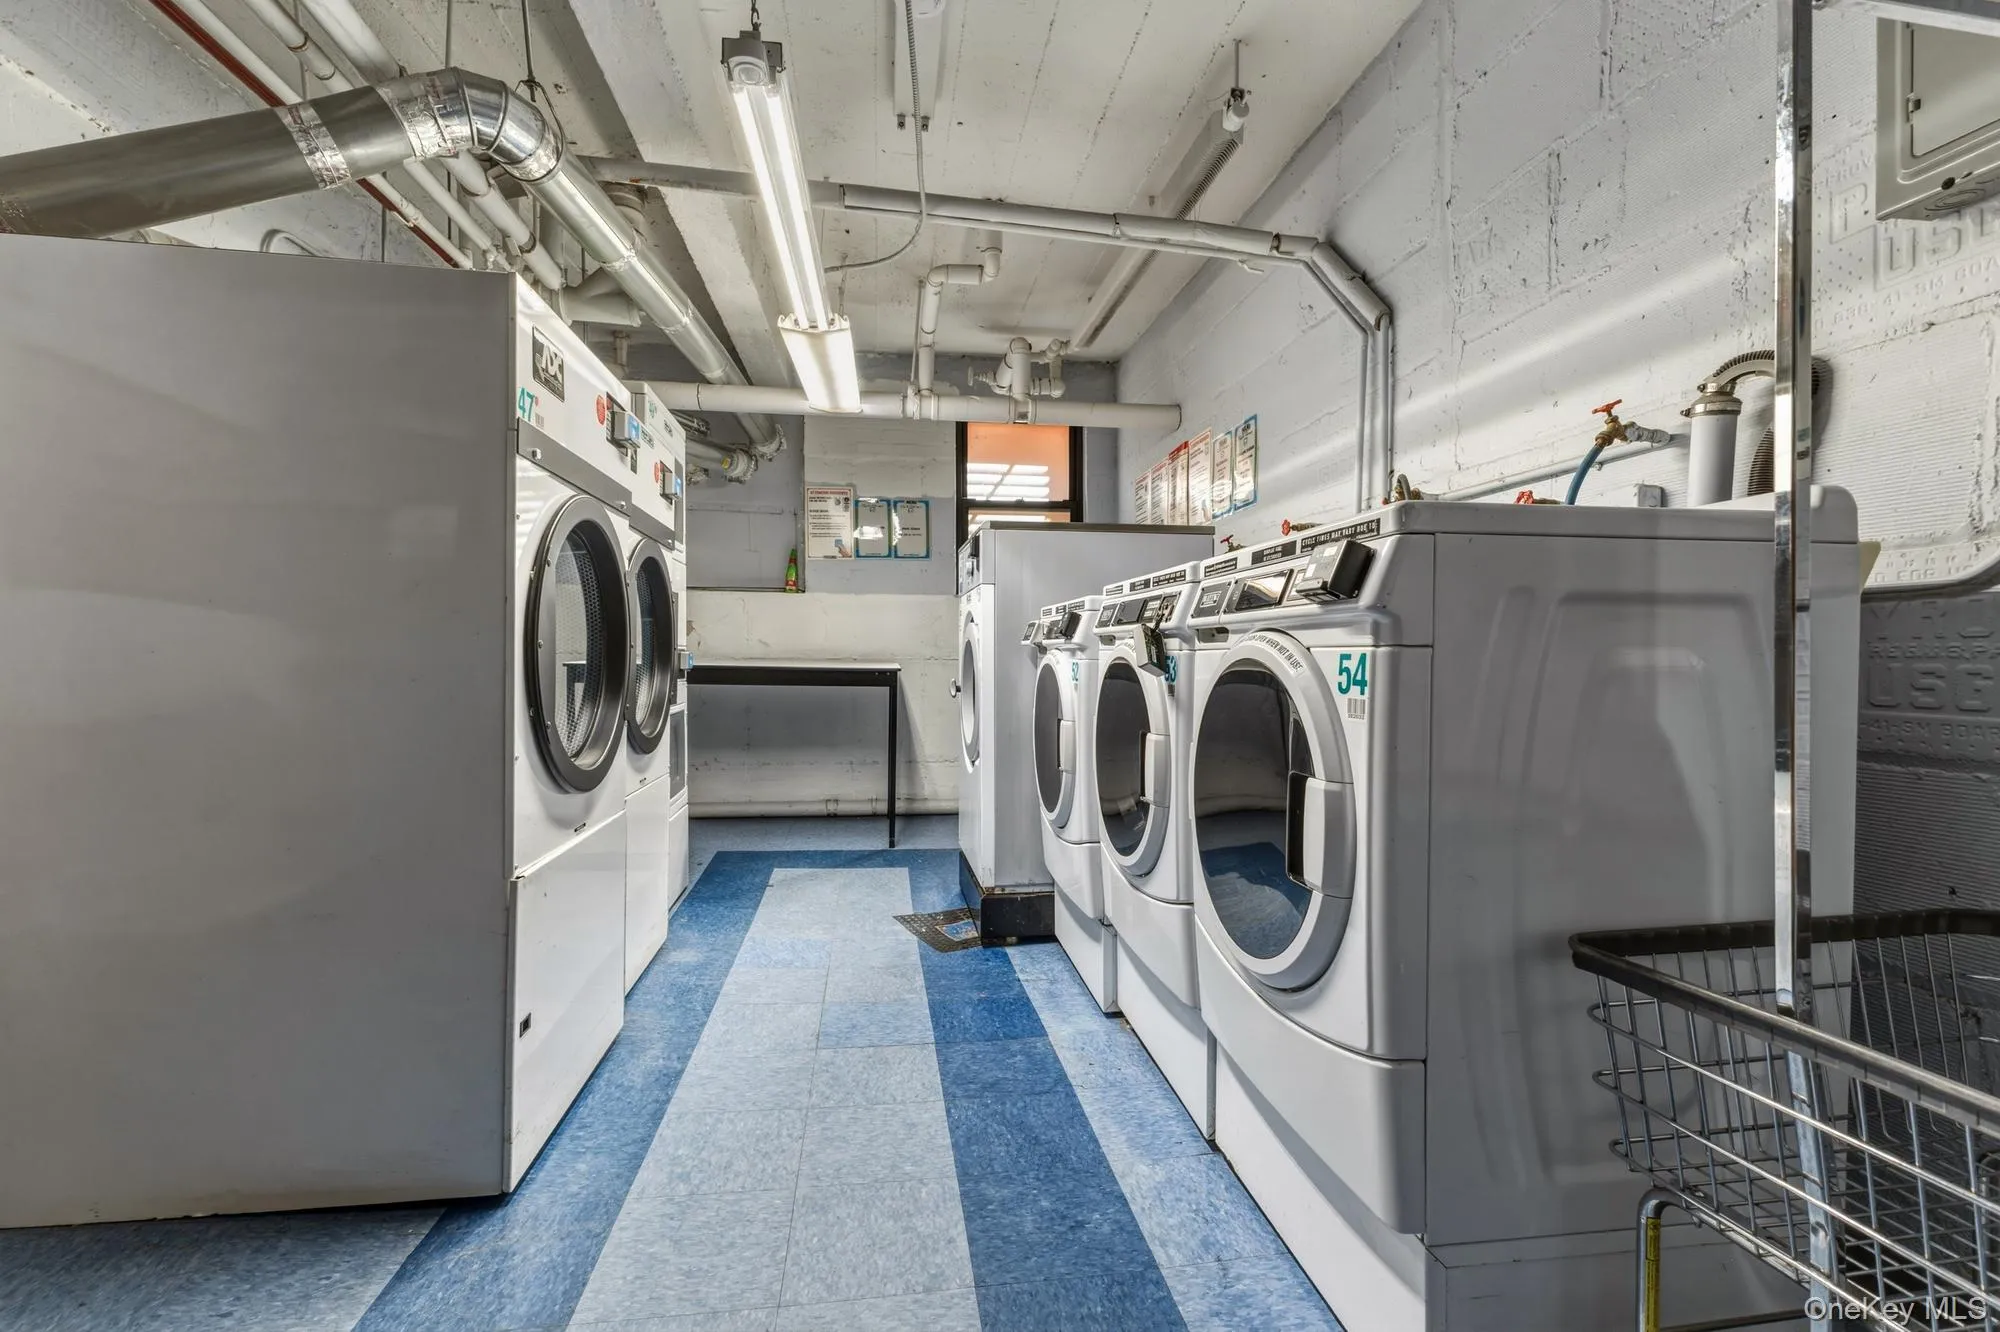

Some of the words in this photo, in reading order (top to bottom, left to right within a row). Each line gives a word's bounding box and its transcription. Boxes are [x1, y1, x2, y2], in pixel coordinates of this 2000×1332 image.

[518, 387, 535, 423] 47
[1302, 537, 1316, 546] CYCLE
[1276, 644, 1289, 656] NOT
[1285, 651, 1295, 662] IN
[1071, 661, 1079, 682] 52
[1165, 655, 1177, 682] 53
[1337, 652, 1368, 696] 54
